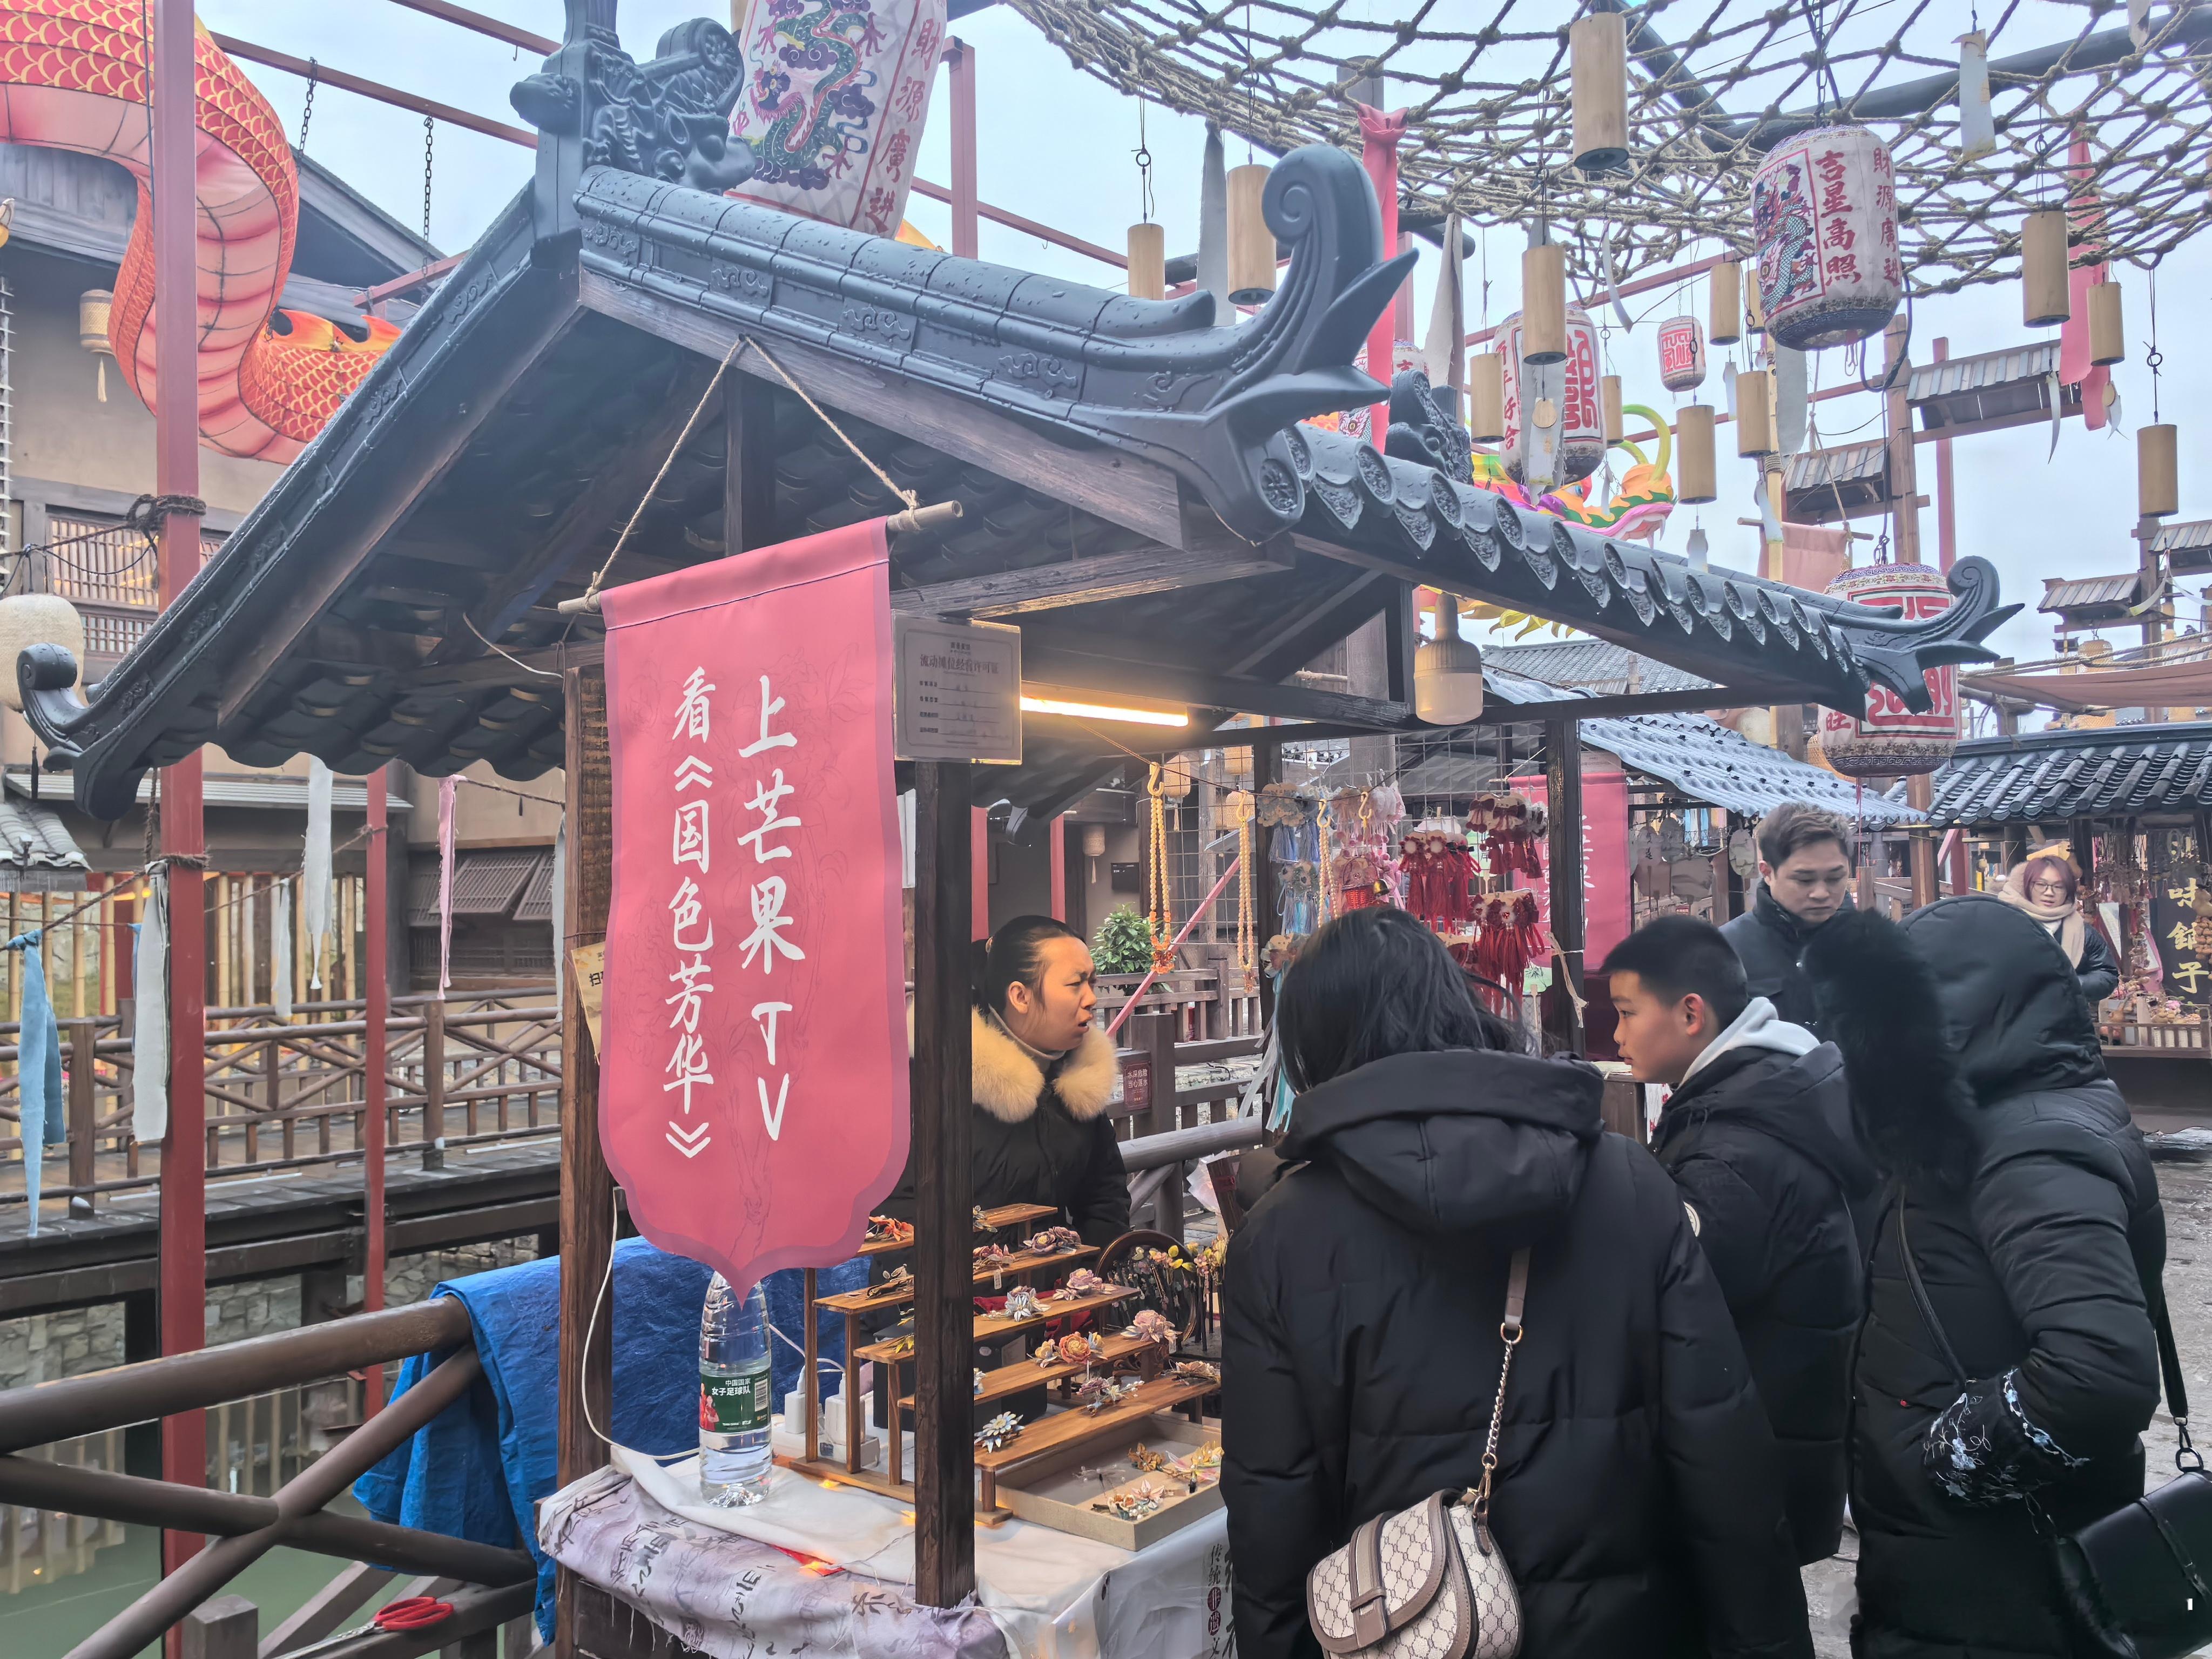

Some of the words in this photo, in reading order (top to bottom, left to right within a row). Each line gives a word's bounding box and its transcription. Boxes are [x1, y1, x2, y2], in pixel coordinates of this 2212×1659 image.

[1815, 150, 1862, 286] 吉星高照
[663, 665, 716, 1158] 看《国色芳华》
[1127, 1068, 1148, 1079] 水深危险
[1128, 1078, 1148, 1089] 当心落水
[725, 1378, 751, 1387] 中国国家
[711, 1385, 751, 1396] 女子足球队
